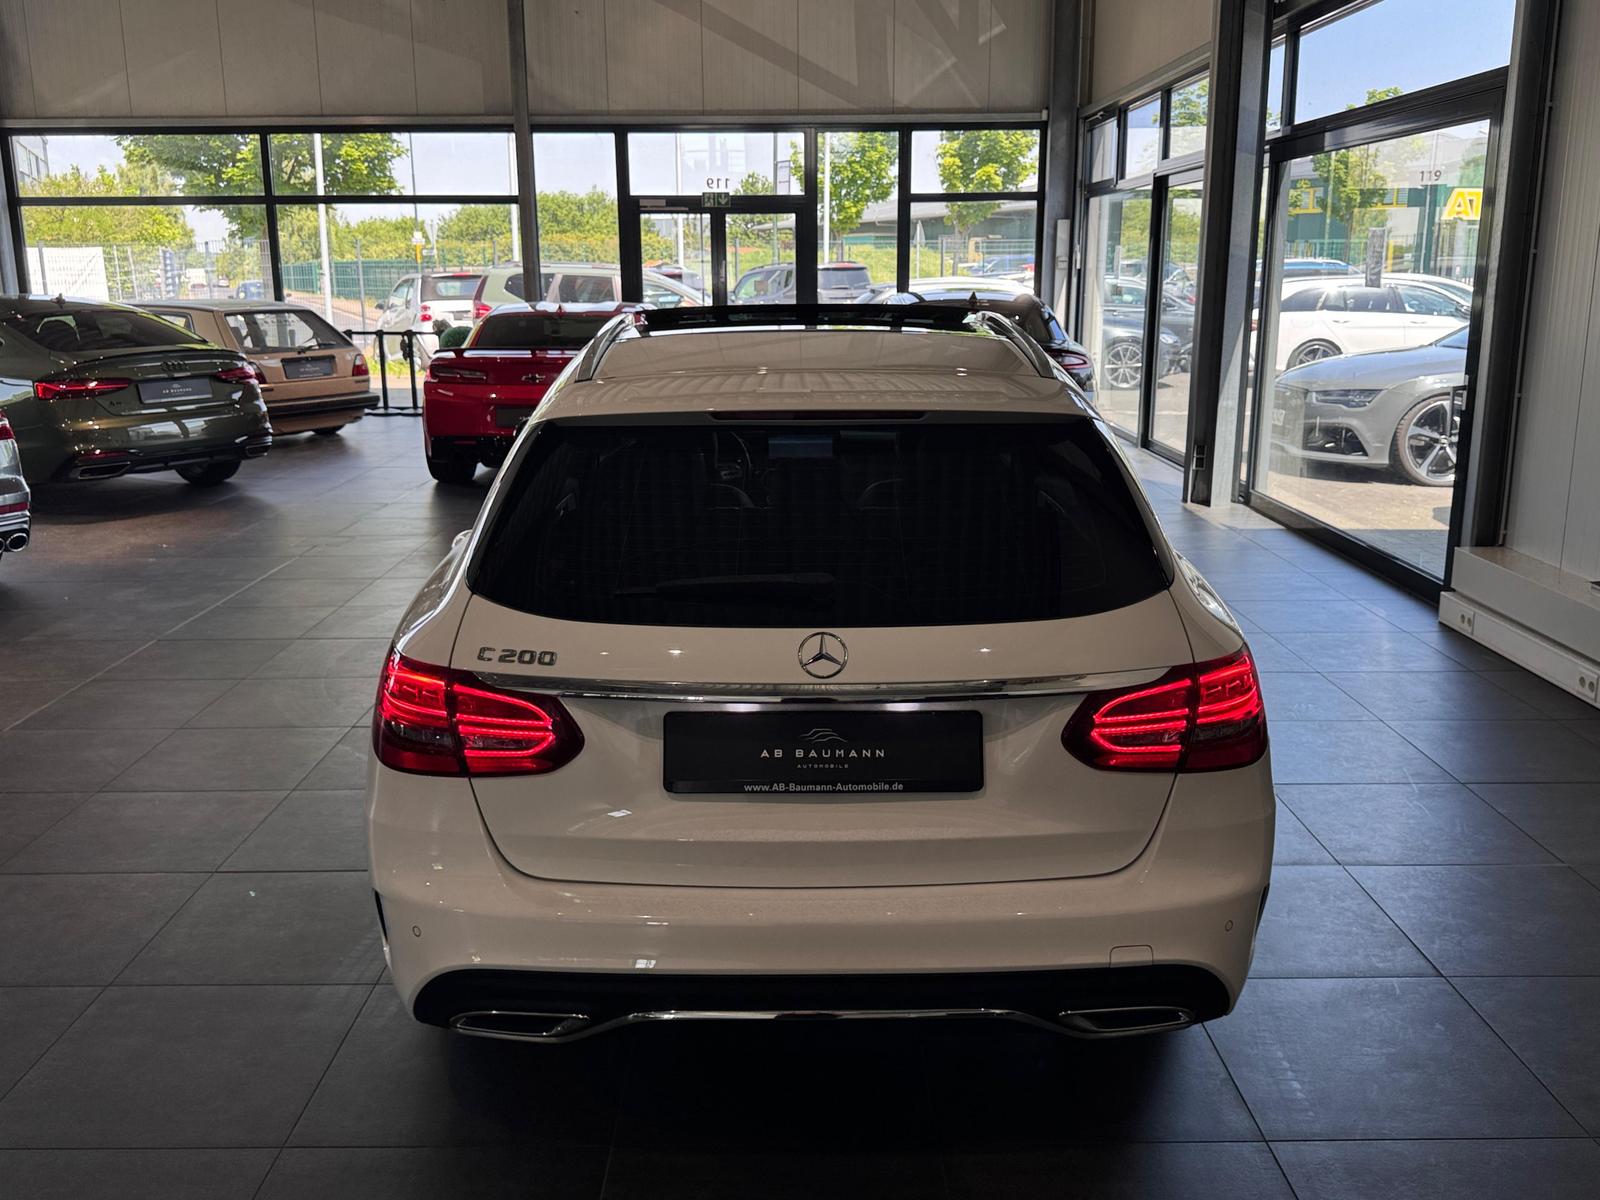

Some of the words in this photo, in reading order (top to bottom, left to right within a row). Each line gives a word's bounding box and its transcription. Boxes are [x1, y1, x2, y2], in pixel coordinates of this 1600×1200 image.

[1419, 169, 1442, 182] 119
[477, 646, 496, 662] C
[498, 648, 558, 666] 200
[760, 748, 783, 758] AB
[795, 748, 886, 758] BAUMANN
[744, 782, 904, 792] www.AB-Baumann-Automobile.de
